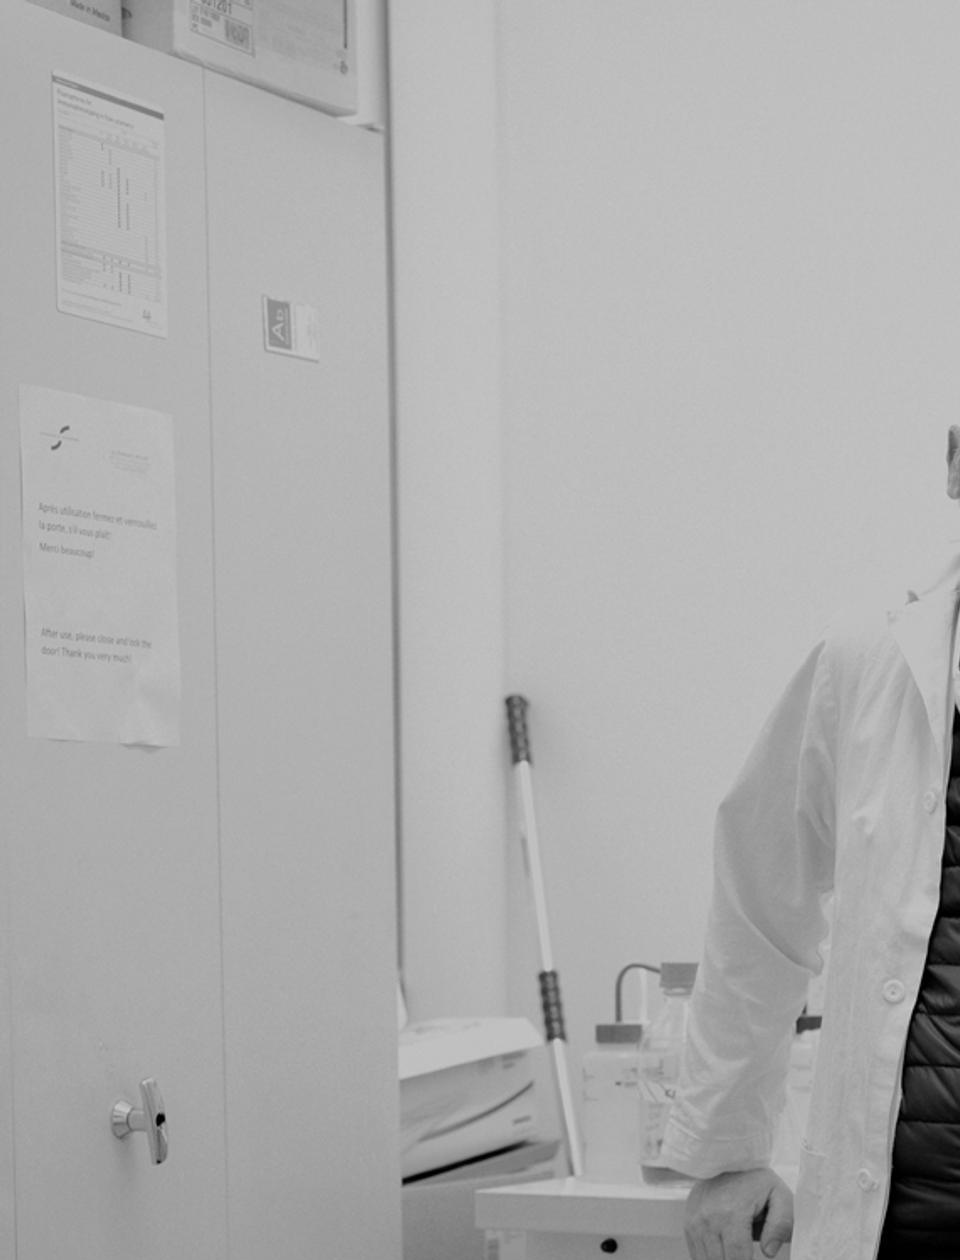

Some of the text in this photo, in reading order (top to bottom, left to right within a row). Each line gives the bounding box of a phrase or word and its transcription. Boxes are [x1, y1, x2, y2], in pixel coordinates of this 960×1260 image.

[39, 542, 59, 553] Merci
[75, 631, 96, 643] please
[61, 647, 82, 659] Thank
[83, 651, 96, 662] you
